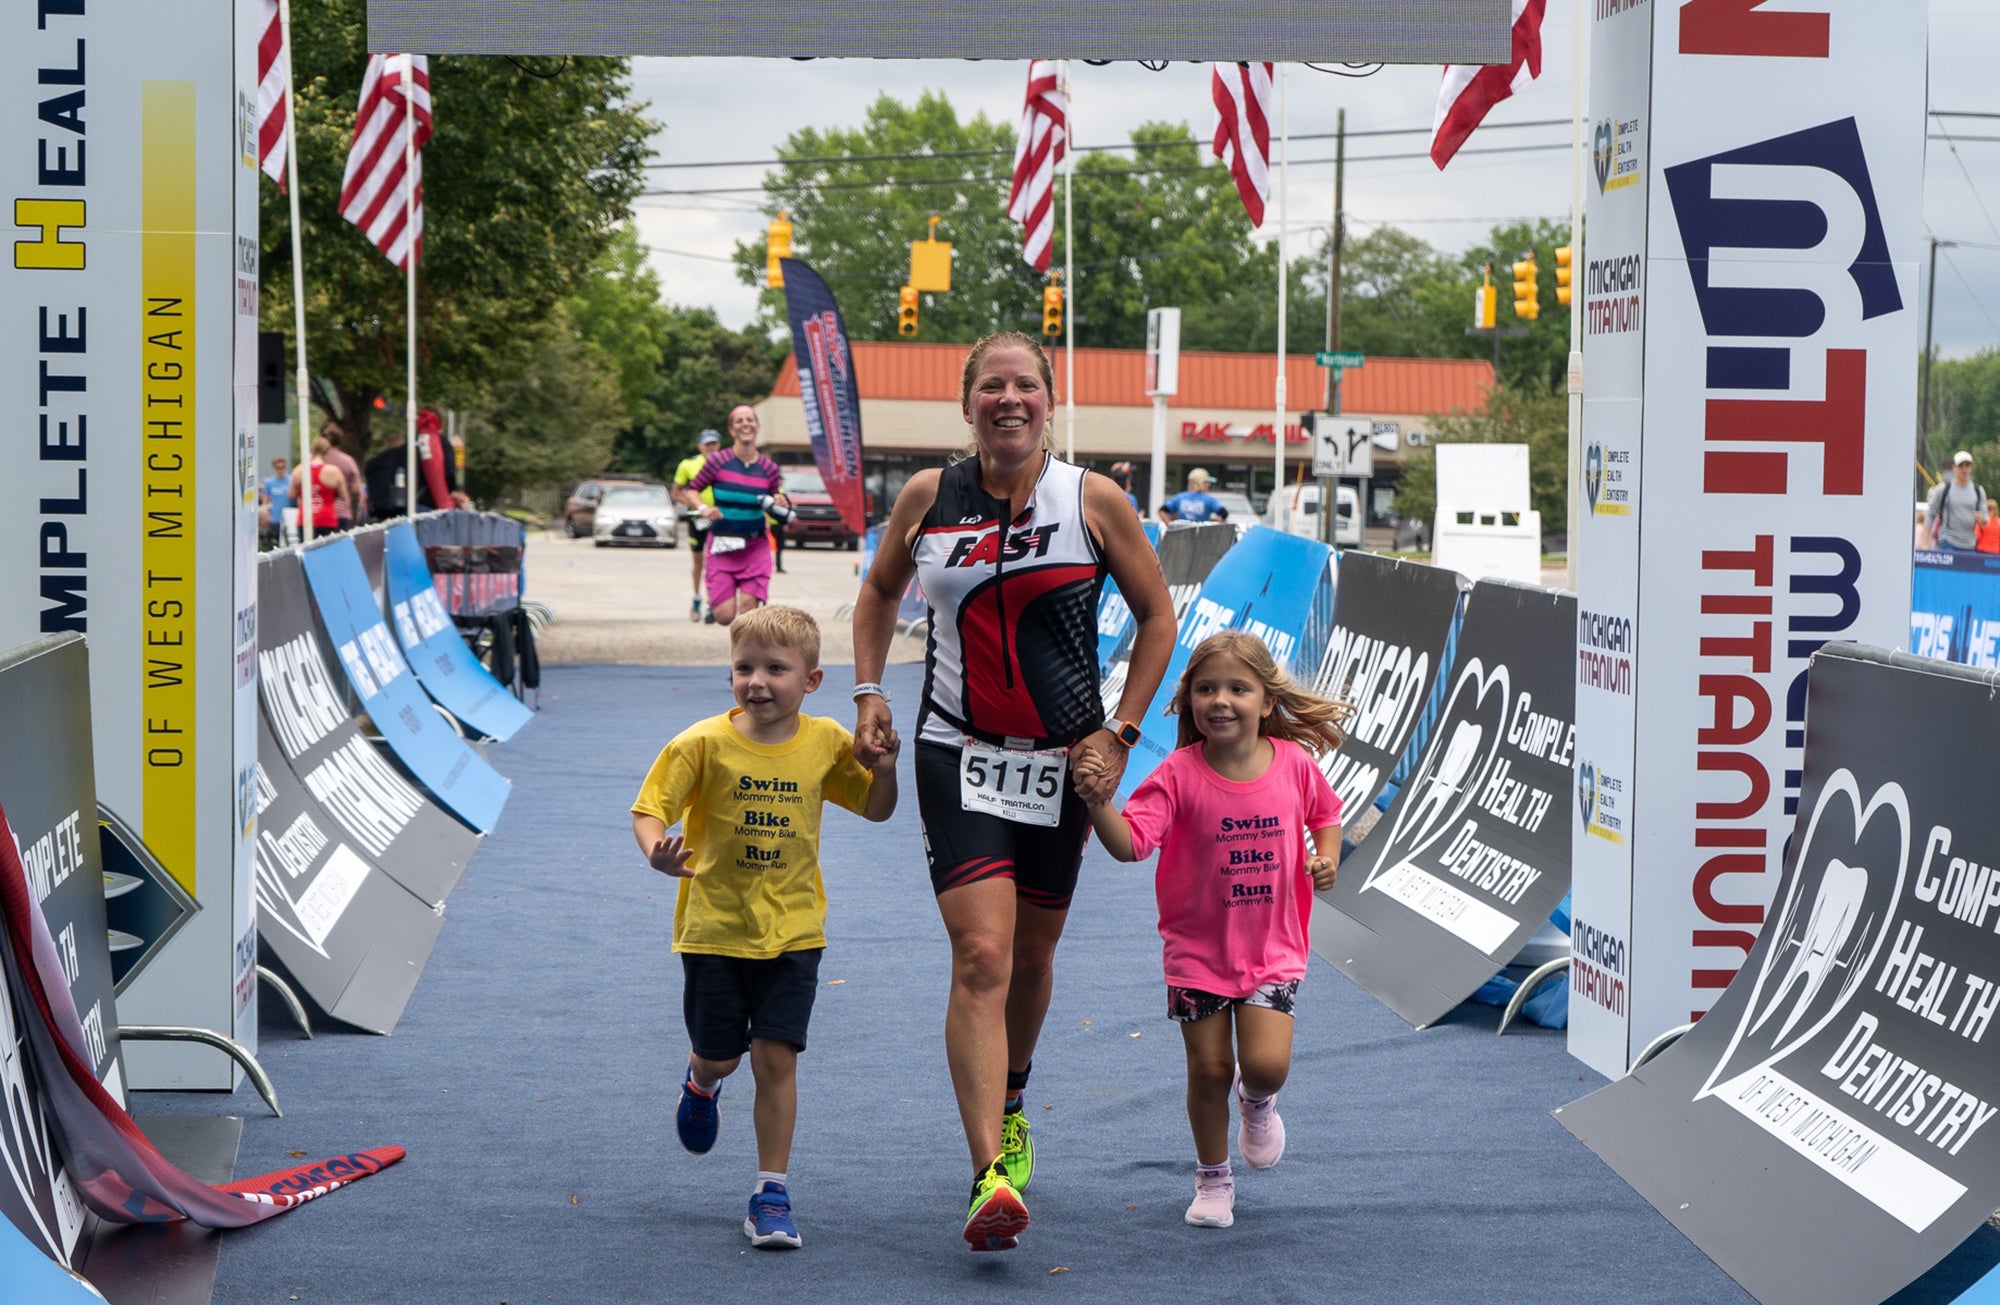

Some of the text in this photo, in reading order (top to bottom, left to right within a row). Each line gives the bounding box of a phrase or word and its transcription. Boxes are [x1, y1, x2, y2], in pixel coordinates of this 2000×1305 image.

[1614, 119, 1639, 136] COMPLETE
[1614, 139, 1632, 156] HEALTH
[1613, 158, 1638, 175] DENTISTRY
[1589, 254, 1640, 294] MICHIGAN
[1588, 295, 1639, 335] TITANIUM
[1181, 422, 1232, 442] PAK
[148, 297, 183, 766] OF WEST MICHIGAN
[944, 522, 1061, 569] FAST
[1580, 609, 1631, 654] MICHIGAN
[1579, 650, 1630, 696] TITANIUM
[259, 630, 350, 760] MICHIGAN
[1311, 624, 1430, 756] MICHIGAN
[1507, 691, 1576, 770] COMPLE
[739, 775, 798, 792] Swim
[966, 755, 1059, 798] 5115
[1596, 768, 1622, 792] COMPLETE
[304, 732, 426, 858] TITANIUM
[733, 791, 803, 804] Mommy Swim
[977, 793, 1045, 811] HALF TRIATHLON
[1478, 757, 1553, 833] HEALTH
[1596, 787, 1615, 808] HEALTH
[743, 810, 790, 827] Bike
[1221, 815, 1279, 832] Swim
[1595, 805, 1621, 830] DENTISTRY
[734, 826, 797, 839] Mommy Bike
[1215, 829, 1285, 843] Mommy Swim
[14, 810, 84, 905] OMPLETE
[745, 845, 781, 861] Run
[770, 861, 787, 869] Run
[1229, 849, 1274, 865] Bike
[1438, 819, 1542, 905] DENTISTRY
[1220, 863, 1280, 876] Mommy Bik
[1232, 883, 1272, 898] Run
[1223, 898, 1262, 909] Mommy
[1573, 917, 1625, 976] MICHIGAN
[1573, 960, 1624, 1018] TITANIUM
[1874, 919, 2000, 1044] HEALTH
[1820, 1011, 1998, 1156] DENTISTRY
[1738, 1075, 1881, 1175] OF WEST MICHIGAN
